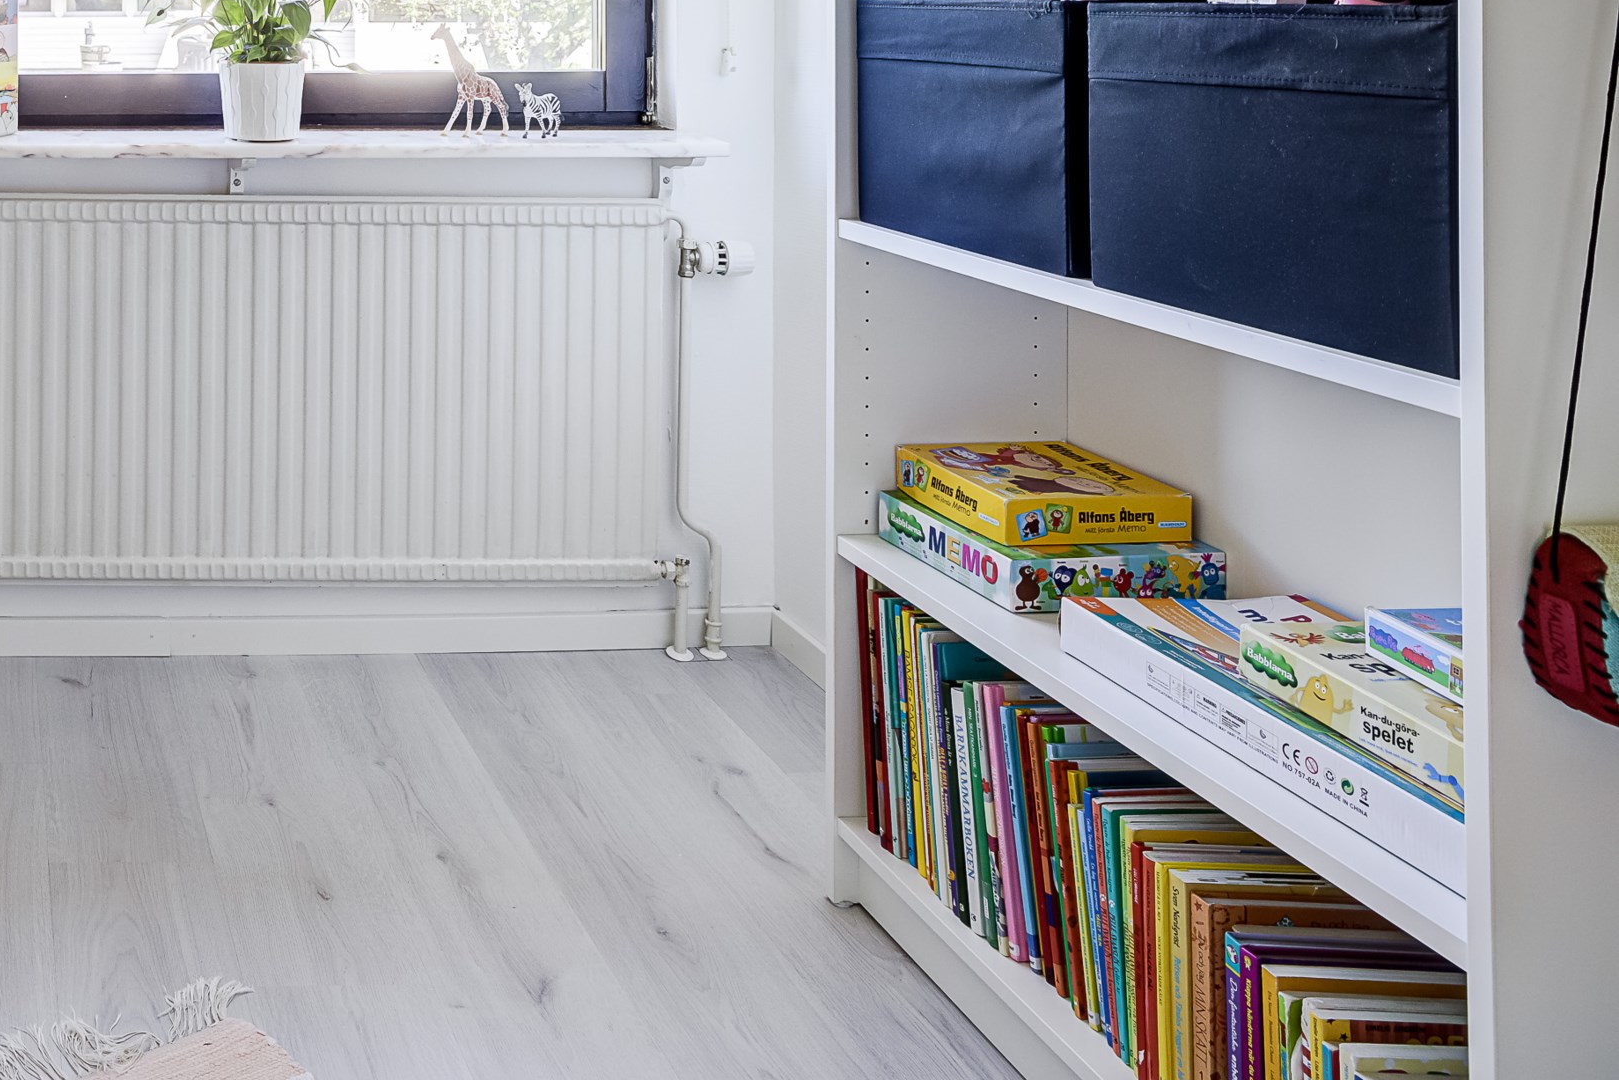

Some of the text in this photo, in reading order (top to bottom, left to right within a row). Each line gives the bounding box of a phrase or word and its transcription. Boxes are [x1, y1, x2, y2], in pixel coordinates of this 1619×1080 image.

[931, 476, 978, 512] Alfons Åberg
[952, 500, 971, 517] Memo
[1078, 507, 1154, 524] Alfons Åberg
[1117, 524, 1146, 533] Memo
[928, 525, 999, 585] MEMO
[1547, 599, 1570, 676] MALLORCA
[968, 722, 977, 768] SKATTKAMMARE
[1363, 722, 1414, 754] spelet
[1282, 742, 1301, 766] CE
[954, 714, 974, 880] BARNKAMMARBOKEN
[1324, 787, 1368, 818] MADE IN CHINA
[1171, 885, 1180, 906] Sven
[1172, 907, 1181, 948] Nordqvist
[1196, 951, 1205, 966] och
[1197, 966, 1205, 984] jag
[1229, 976, 1237, 1000] Den
[1195, 984, 1207, 1020] MIN
[1245, 978, 1253, 1006] Klappa
[1229, 999, 1238, 1052] fantastiska
[1247, 1008, 1255, 1048] händerna
[1195, 1016, 1207, 1068] SKATT
[1249, 1064, 1256, 1076] du
